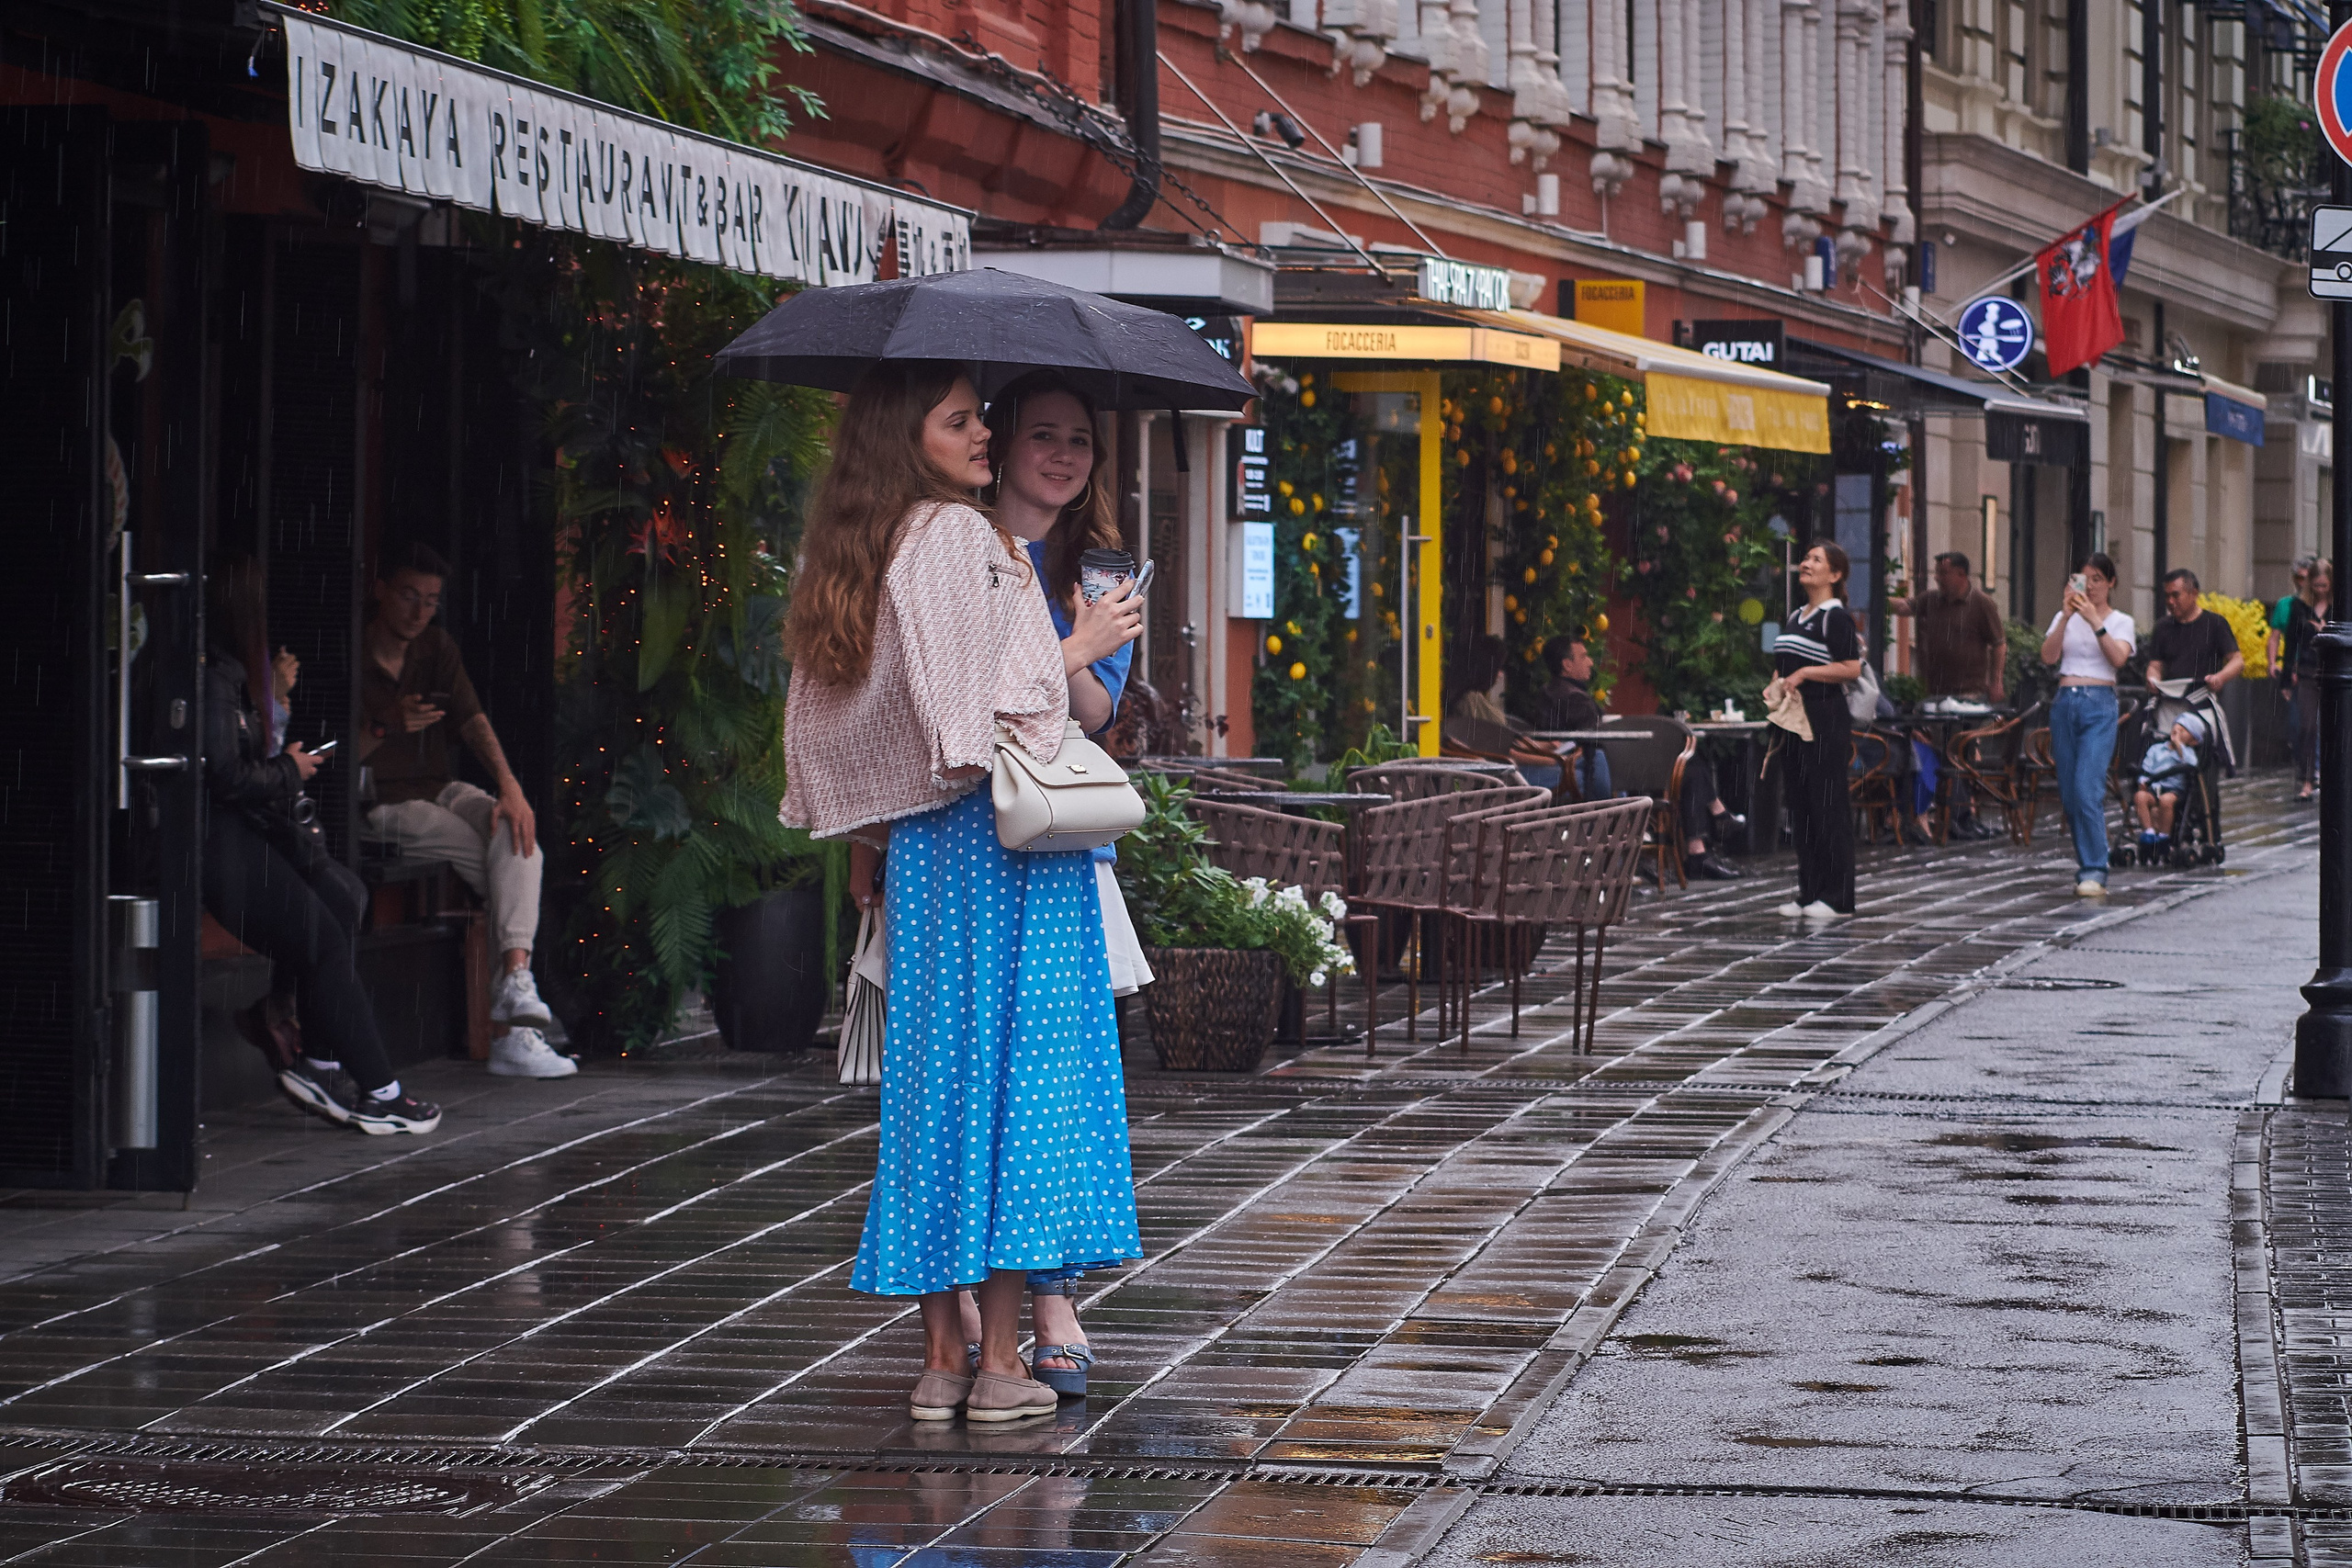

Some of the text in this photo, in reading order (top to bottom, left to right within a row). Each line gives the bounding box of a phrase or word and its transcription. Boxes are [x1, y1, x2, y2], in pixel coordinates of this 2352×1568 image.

[297, 56, 461, 168] IZAKAYA
[1581, 286, 1634, 301] FOCACCERIA
[1326, 332, 1396, 352] FOCACCERIA
[1702, 342, 1774, 362] GUTAI
